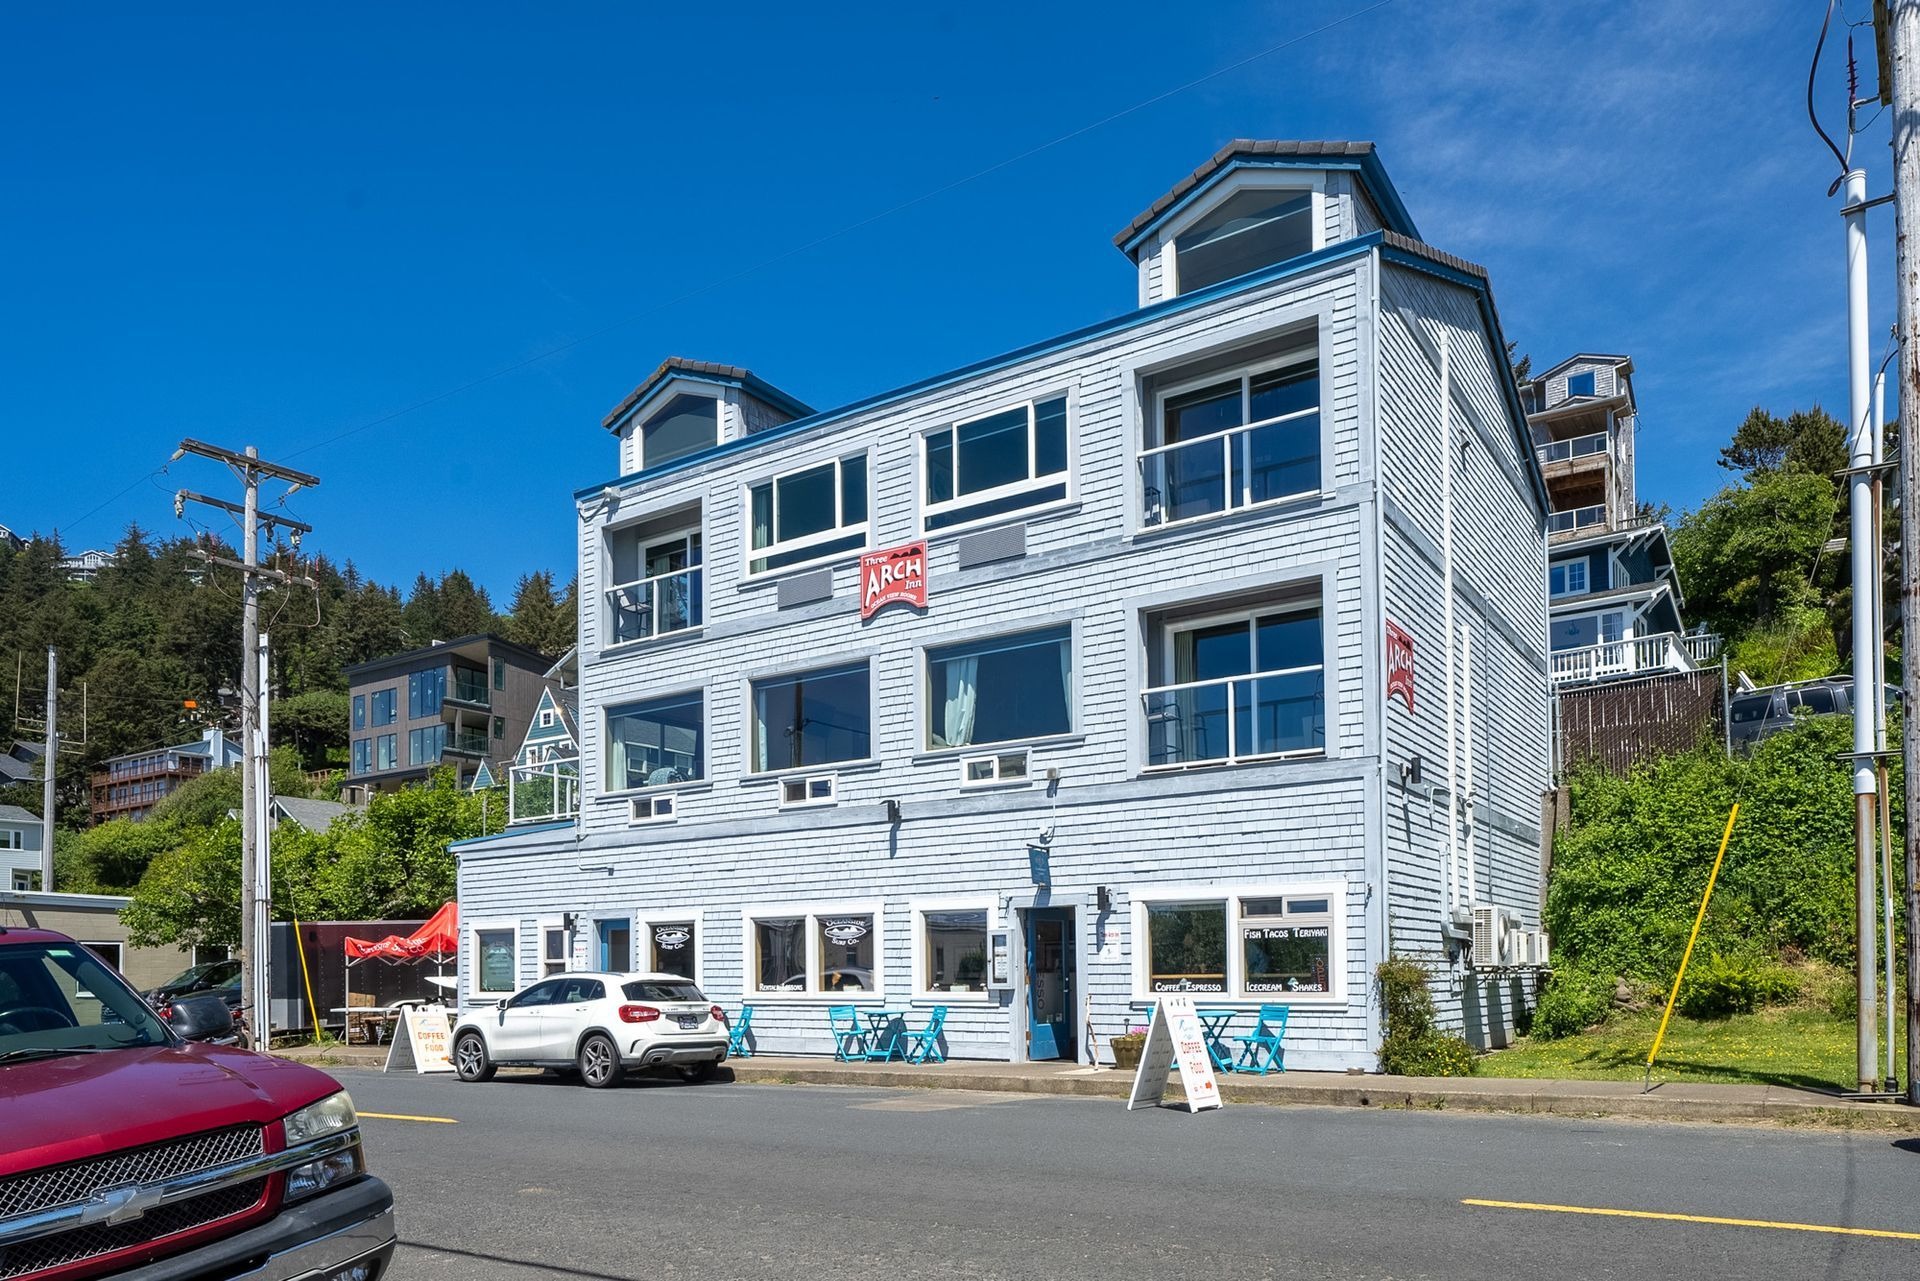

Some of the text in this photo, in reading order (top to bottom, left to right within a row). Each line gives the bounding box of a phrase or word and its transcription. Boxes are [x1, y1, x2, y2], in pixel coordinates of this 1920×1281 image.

[865, 556, 888, 566] Three
[866, 558, 921, 606] ARCH
[905, 580, 922, 590] Inn
[1388, 640, 1412, 685] ARCH
[1244, 927, 1328, 939] FISH TACOS TERIYAKI
[1155, 981, 1222, 992] COFFEE ESPRESSO
[1246, 981, 1323, 992] ICECREAM SHAKES
[417, 1031, 446, 1040] COFFEE
[424, 1043, 444, 1052] FOOD
